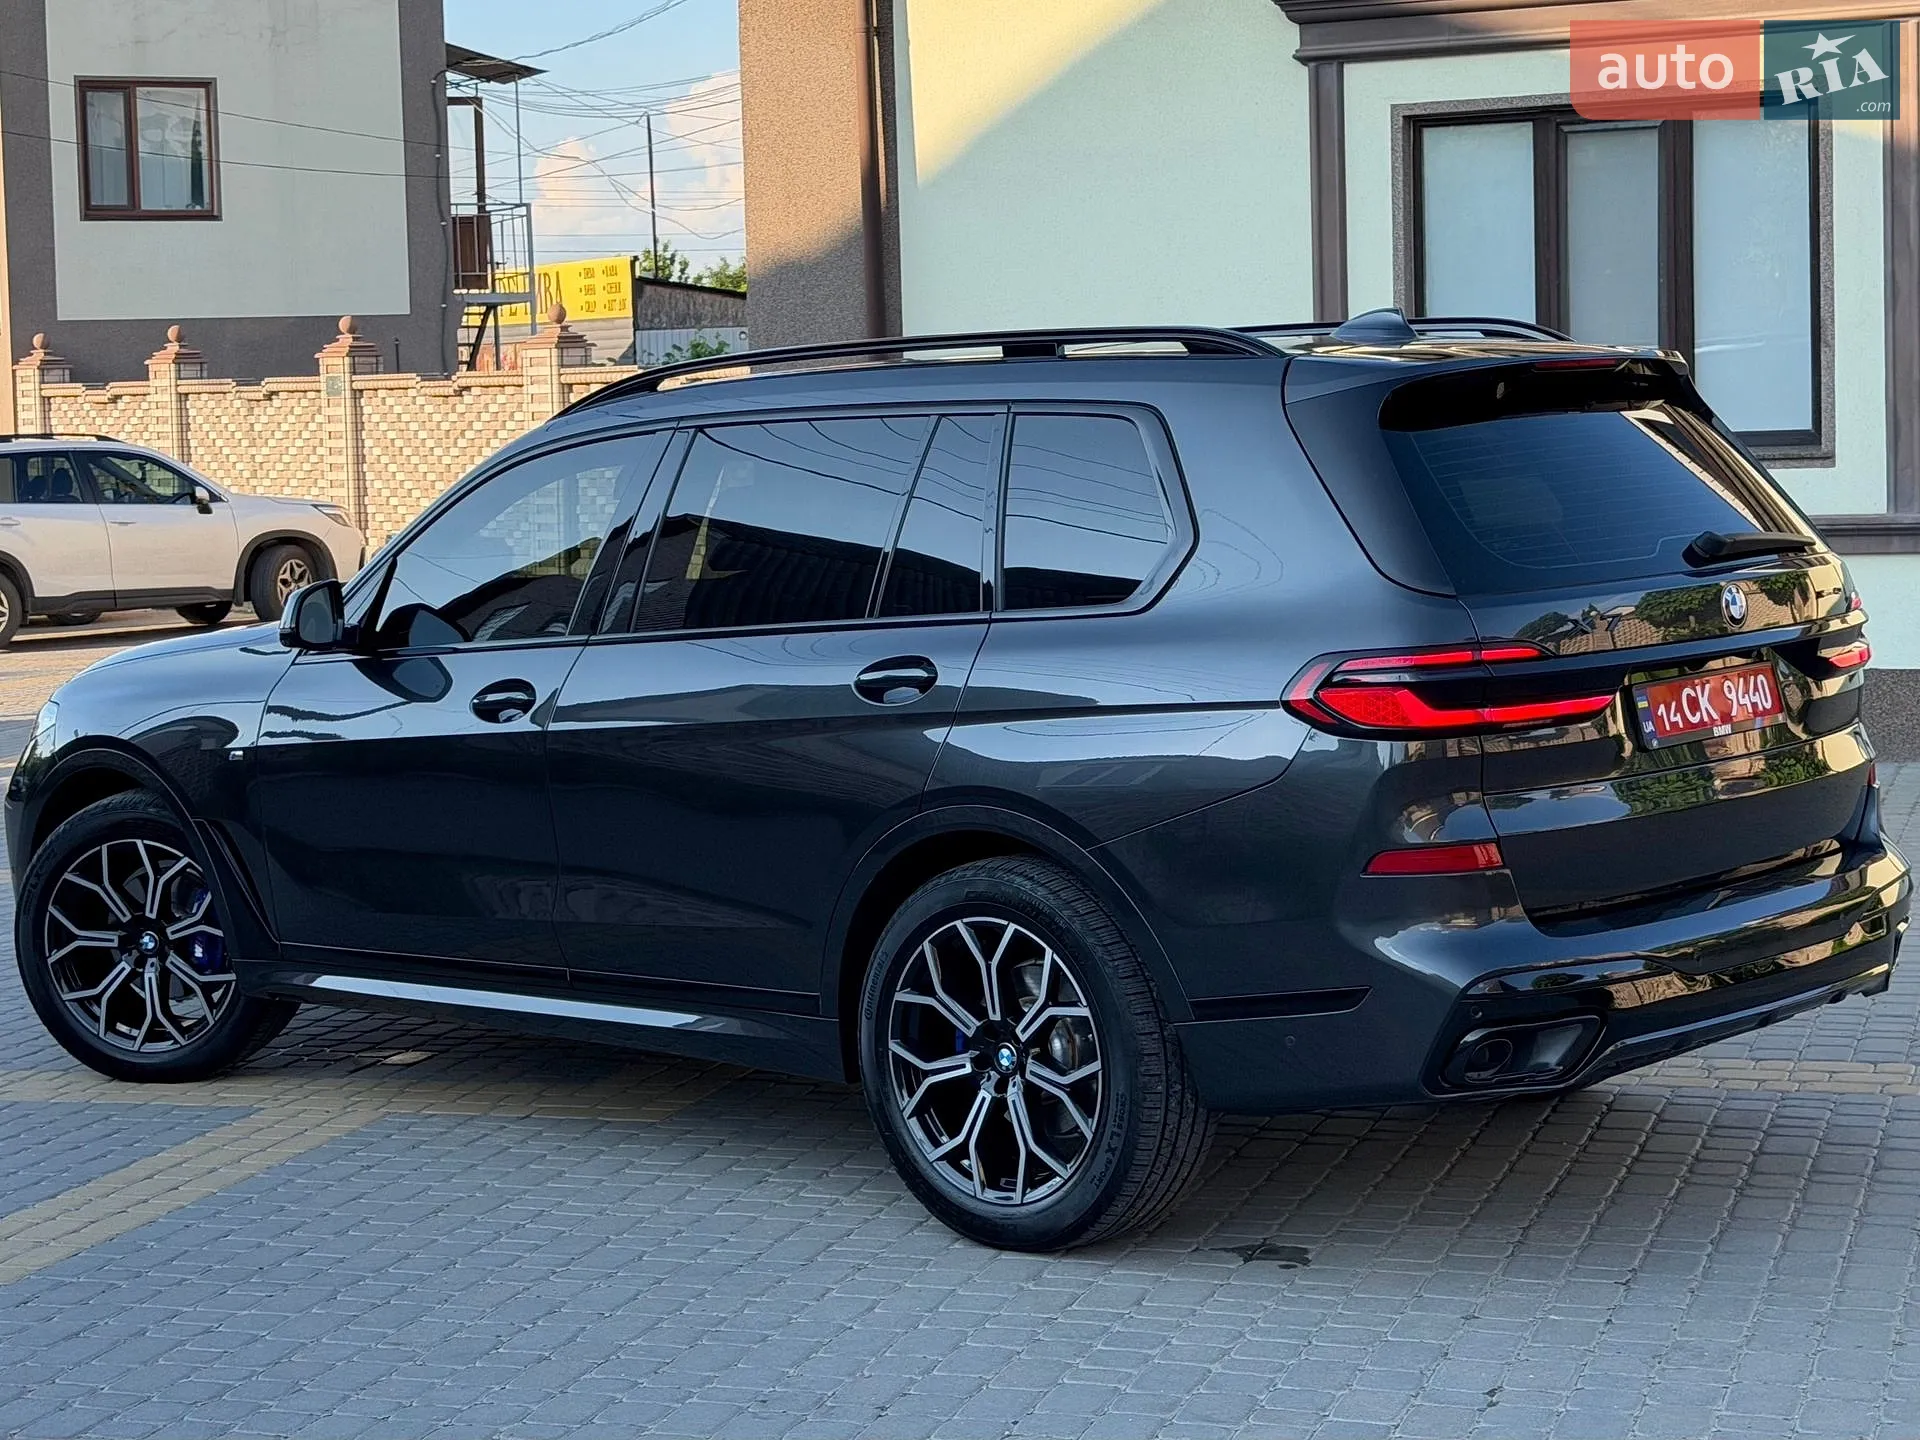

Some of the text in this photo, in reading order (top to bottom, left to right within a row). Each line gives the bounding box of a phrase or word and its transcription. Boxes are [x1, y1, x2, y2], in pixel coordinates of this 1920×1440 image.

[1657, 701, 1683, 731] 14
[1723, 674, 1772, 716] 9440
[1643, 721, 1655, 734] UA
[1713, 723, 1732, 736] BMW
